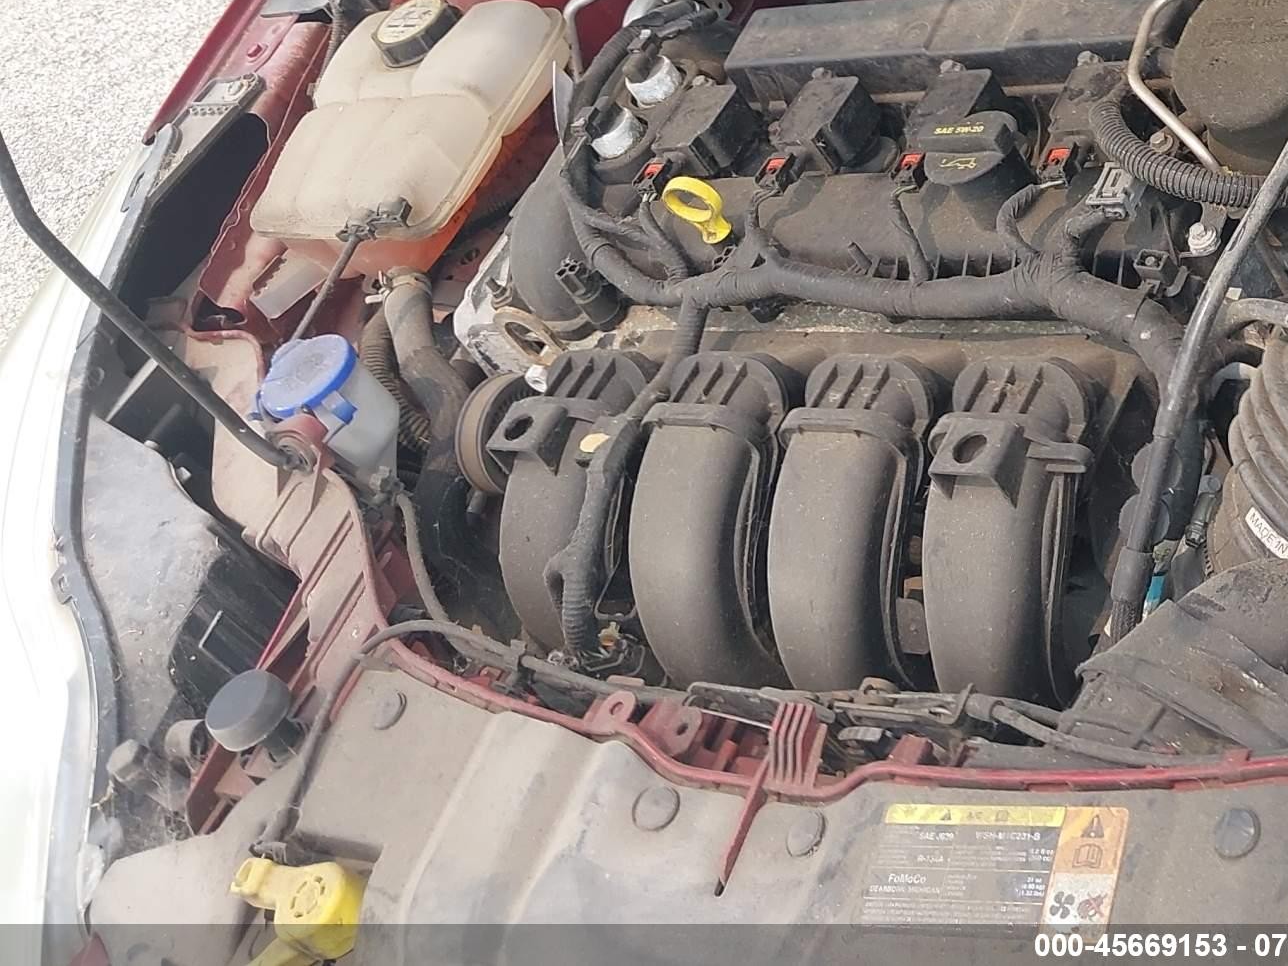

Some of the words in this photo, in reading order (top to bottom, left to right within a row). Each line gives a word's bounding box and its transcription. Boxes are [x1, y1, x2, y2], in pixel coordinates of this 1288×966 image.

[935, 126, 954, 134] SAE
[955, 125, 984, 133] 5W-20
[1249, 512, 1275, 545] MADE
[1273, 540, 1288, 554] IN
[888, 873, 927, 884] FoMoCo
